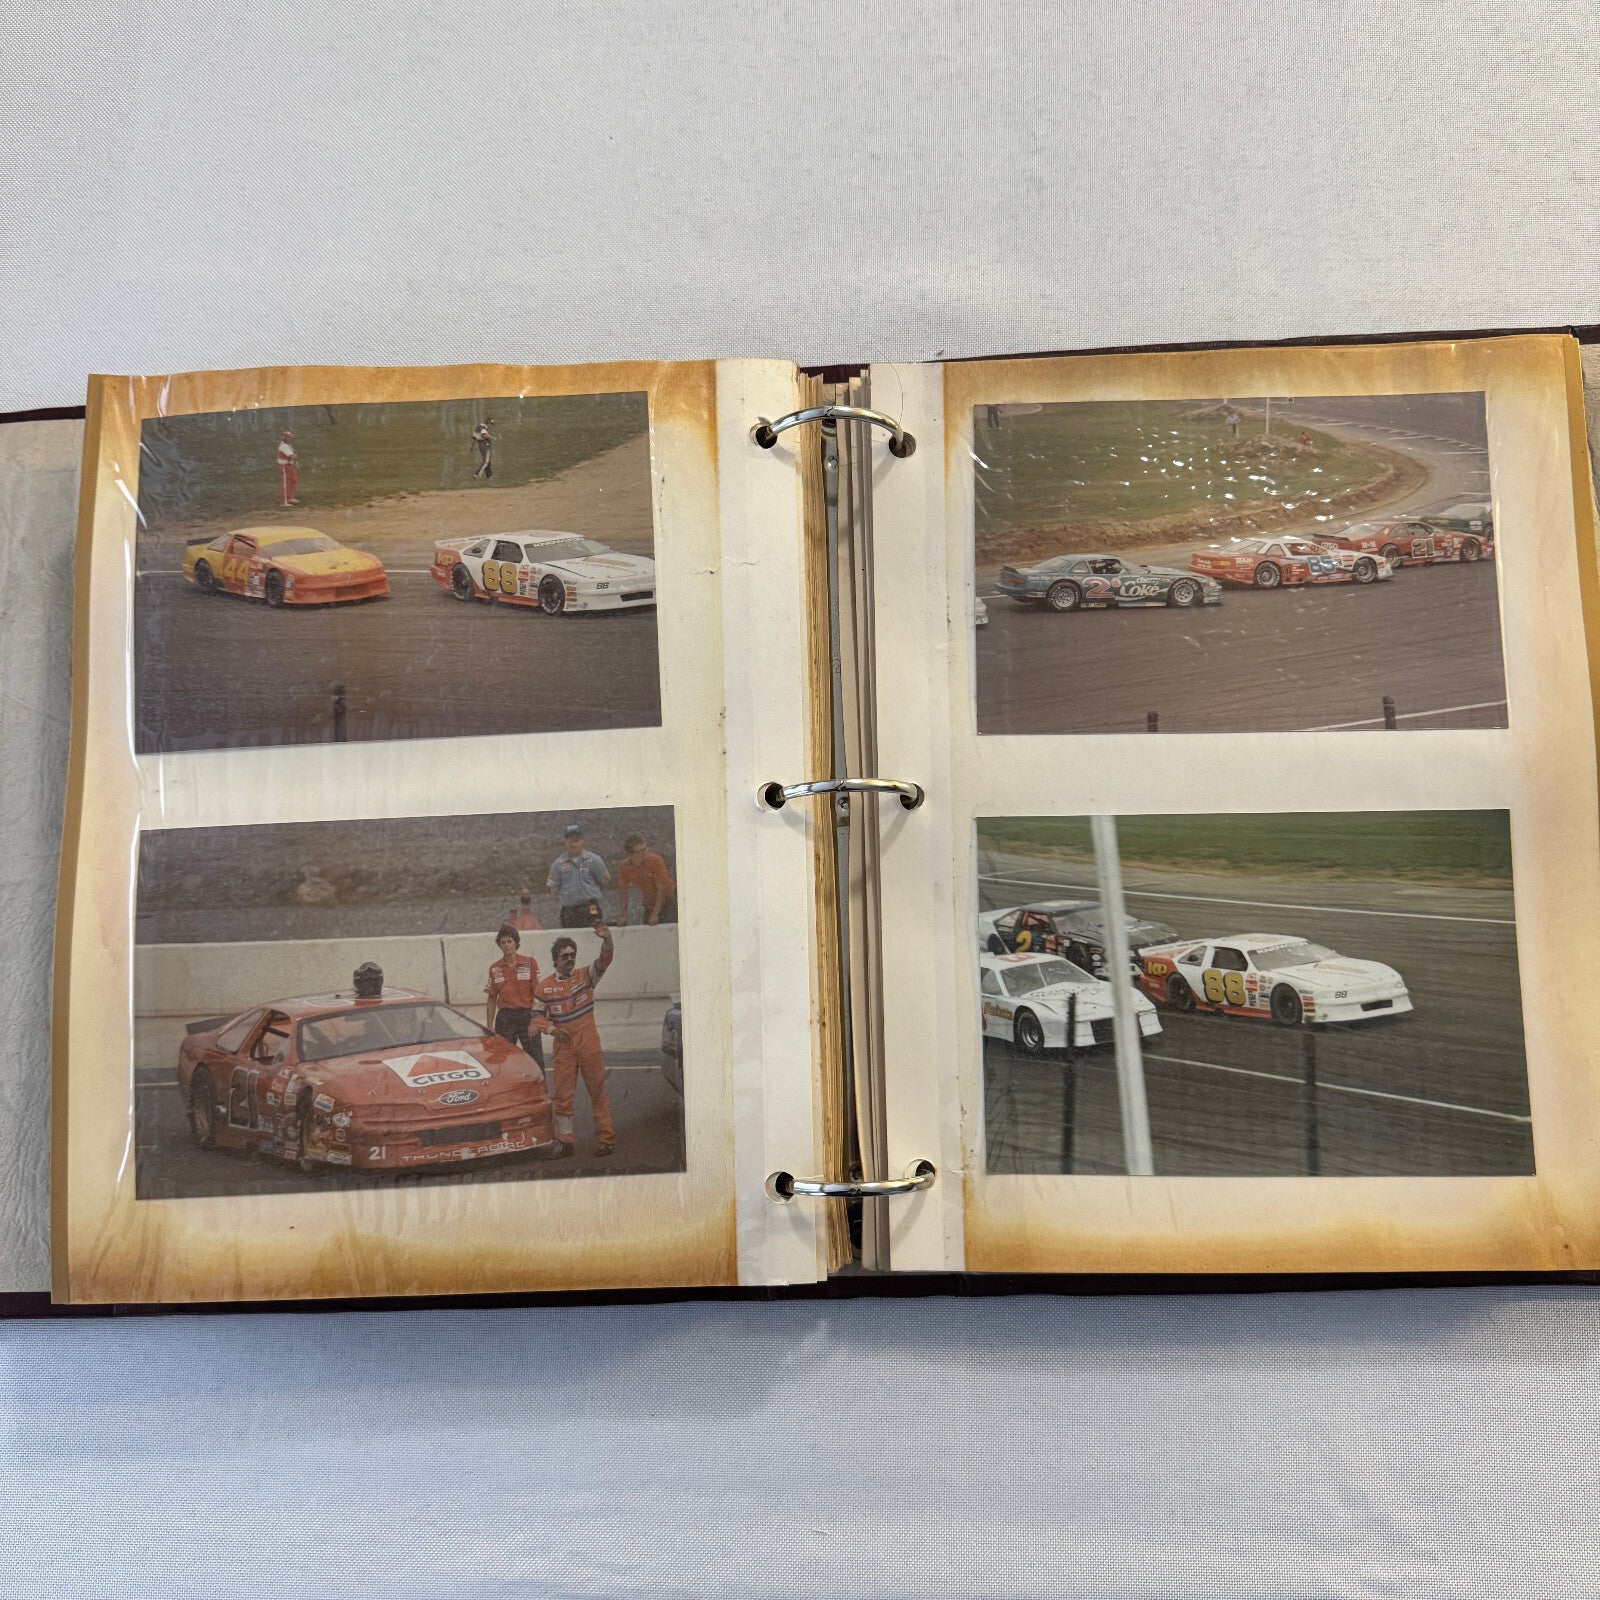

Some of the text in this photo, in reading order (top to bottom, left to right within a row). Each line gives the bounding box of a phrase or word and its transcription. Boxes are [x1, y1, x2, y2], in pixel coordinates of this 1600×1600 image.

[1412, 538, 1434, 558] 21
[223, 558, 251, 586] 44
[482, 560, 517, 595] 88
[596, 582, 609, 590] 88
[1082, 577, 1115, 599] 2
[1120, 581, 1160, 597] Coke
[1015, 931, 1032, 954] 2
[1202, 968, 1246, 1006] 88
[1334, 990, 1348, 999] 88
[412, 1069, 482, 1086] CITGO
[229, 1066, 260, 1131] 21
[446, 1090, 472, 1103] Ford
[369, 1146, 386, 1160] 21
